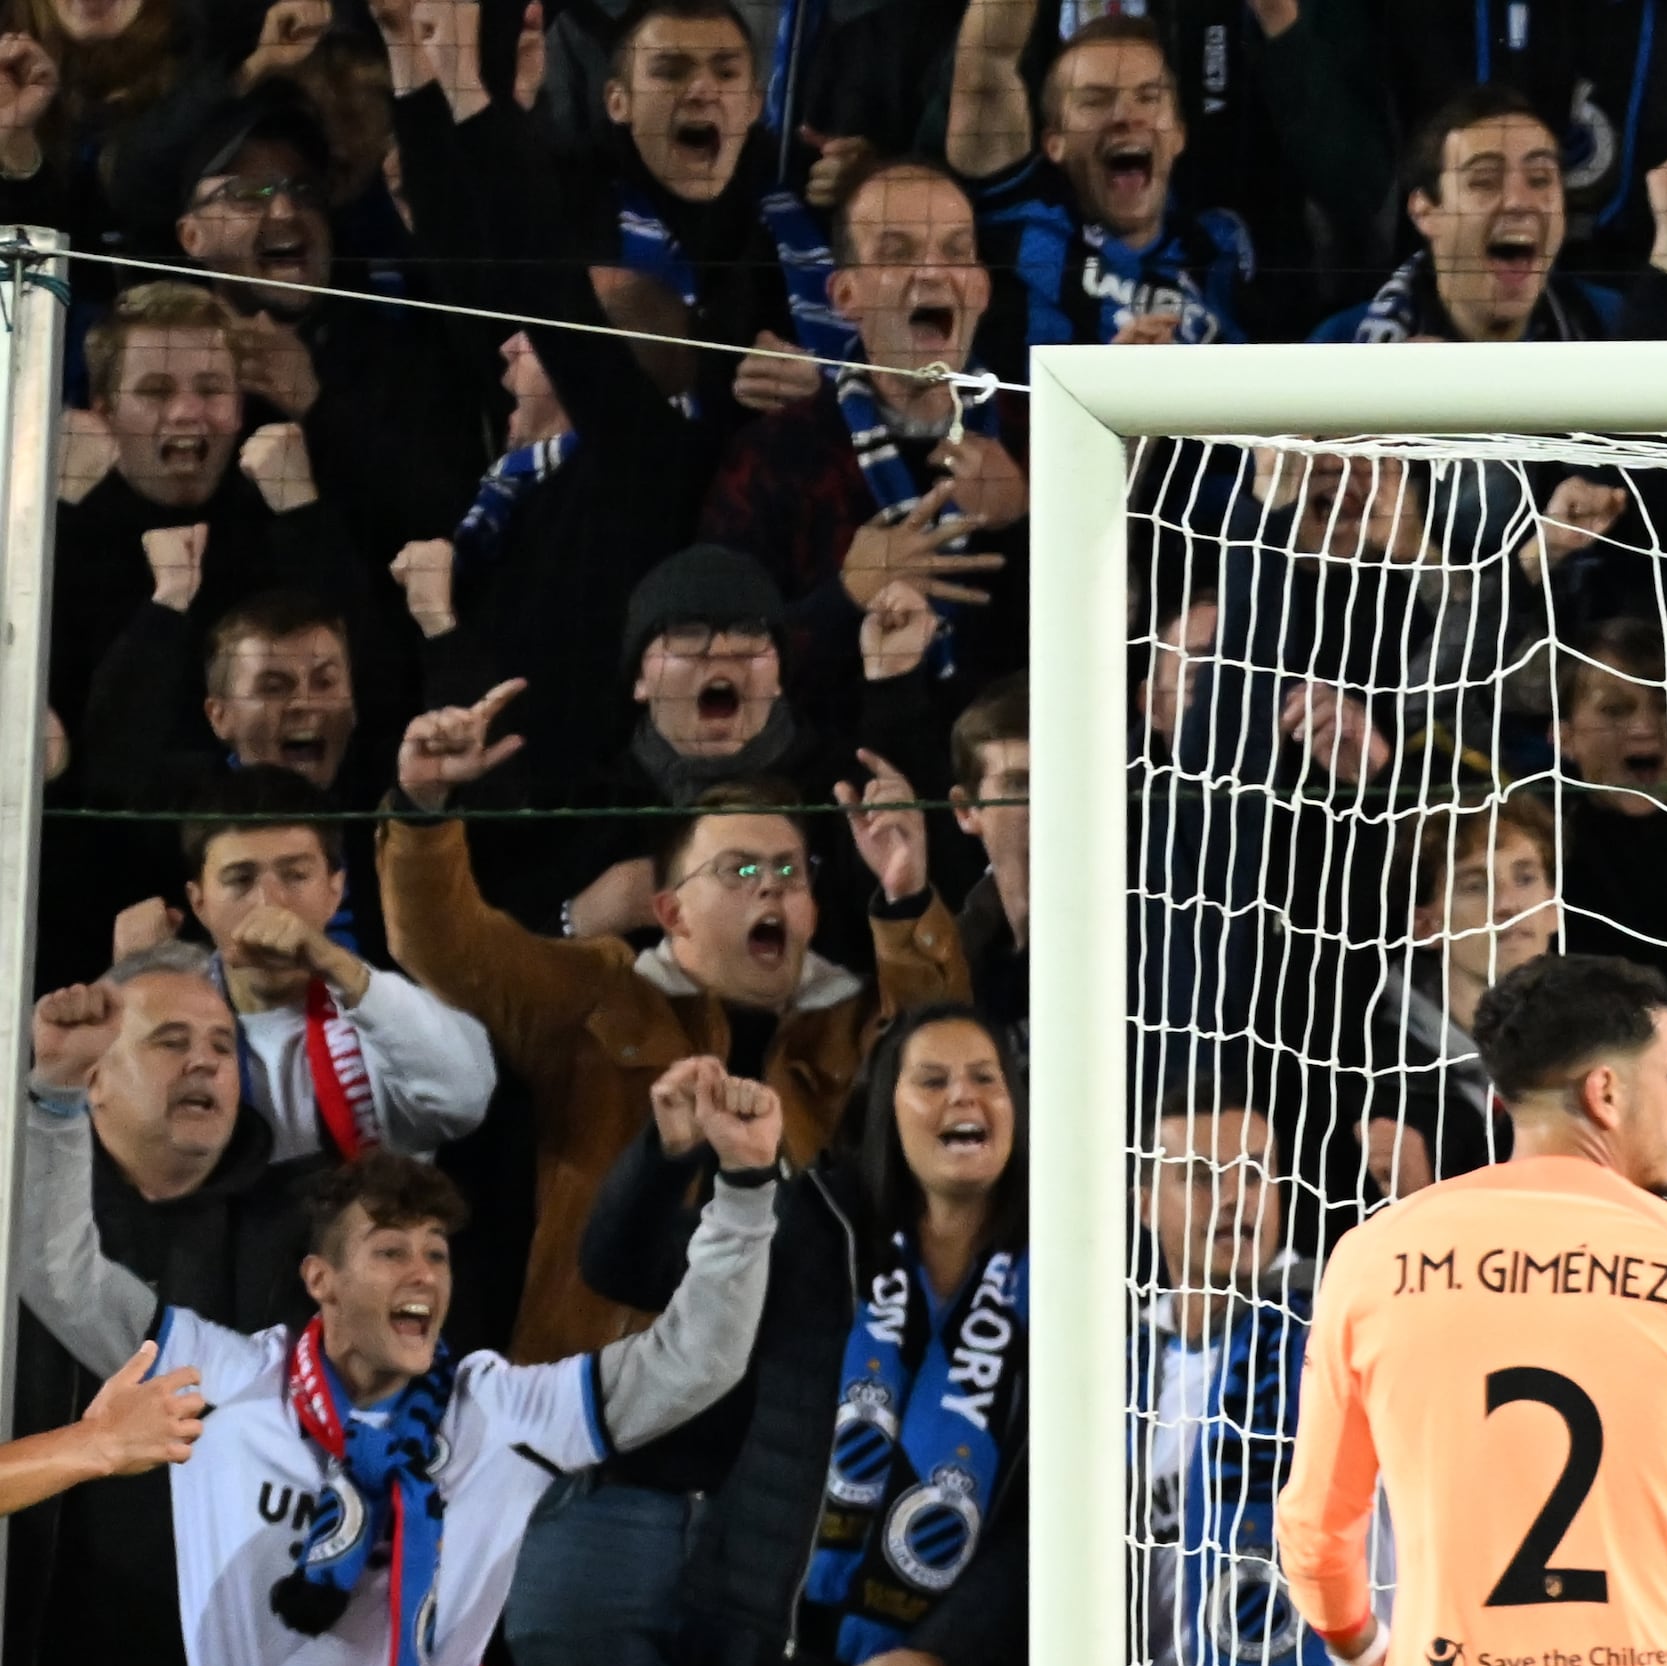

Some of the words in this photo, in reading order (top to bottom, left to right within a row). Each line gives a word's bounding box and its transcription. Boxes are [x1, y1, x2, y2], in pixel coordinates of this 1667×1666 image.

[940, 1251, 1018, 1432] GLORY
[1393, 1247, 1463, 1296] J.M.
[1484, 1366, 1609, 1608] 2
